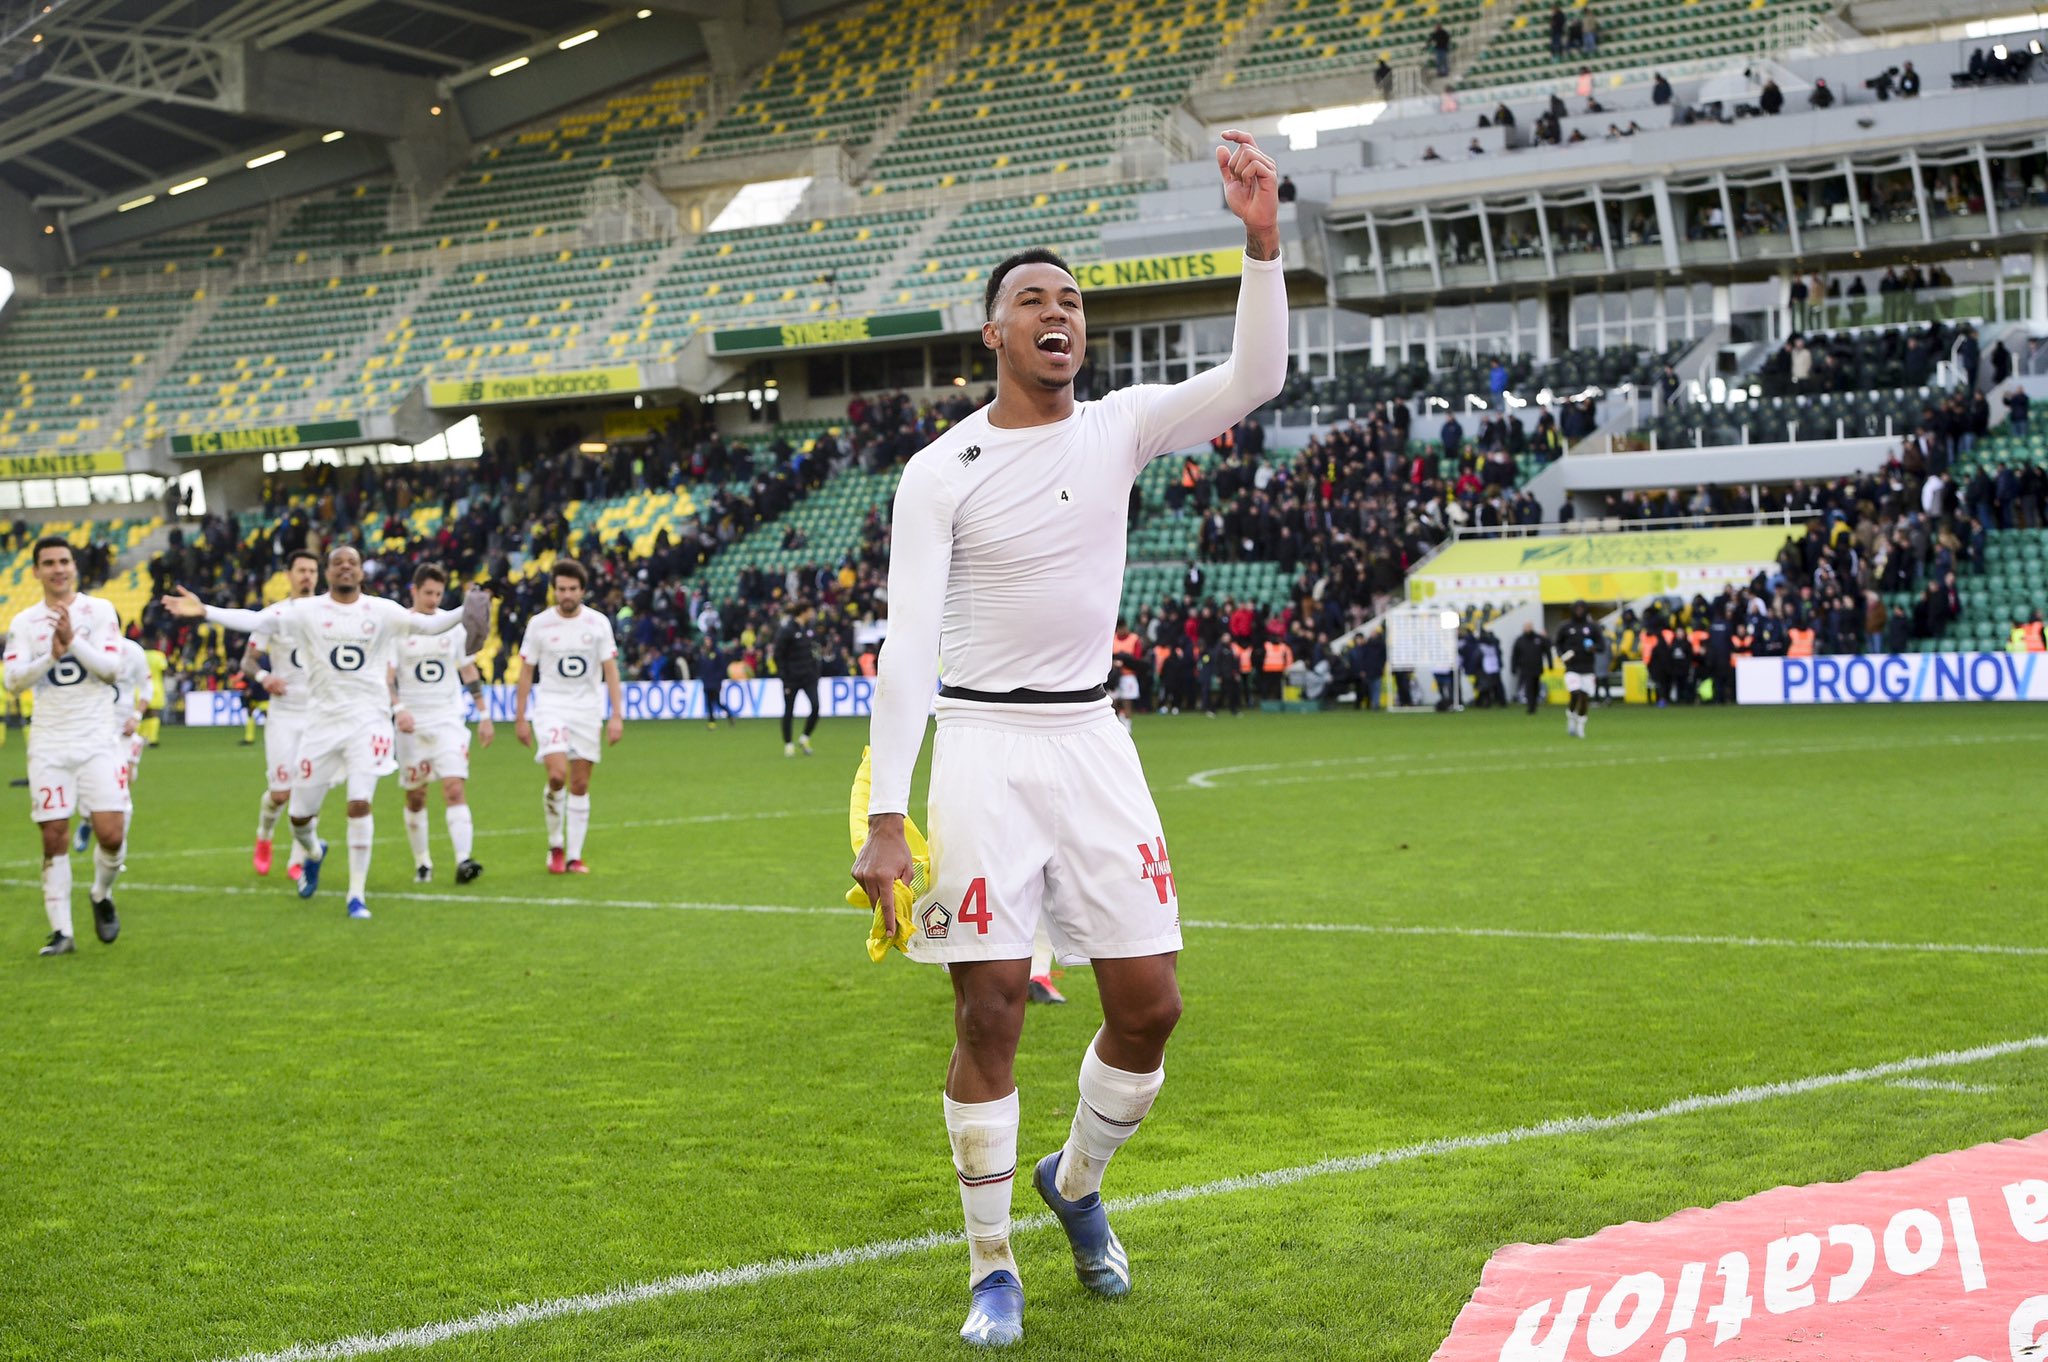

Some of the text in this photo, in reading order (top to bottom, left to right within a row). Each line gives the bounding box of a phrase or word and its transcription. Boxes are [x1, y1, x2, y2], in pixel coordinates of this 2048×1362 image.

[1075, 253, 1217, 288] FC NANTES
[492, 382, 530, 399] new
[532, 374, 610, 395] balance
[191, 425, 301, 454] FC NANTES
[10, 453, 96, 475] NANTES
[1060, 490, 1069, 501] 4
[301, 758, 312, 779] 9
[39, 785, 68, 809] 21
[957, 878, 993, 935] 4
[929, 928, 945, 936] LOSC
[1499, 1196, 1988, 1362] location
